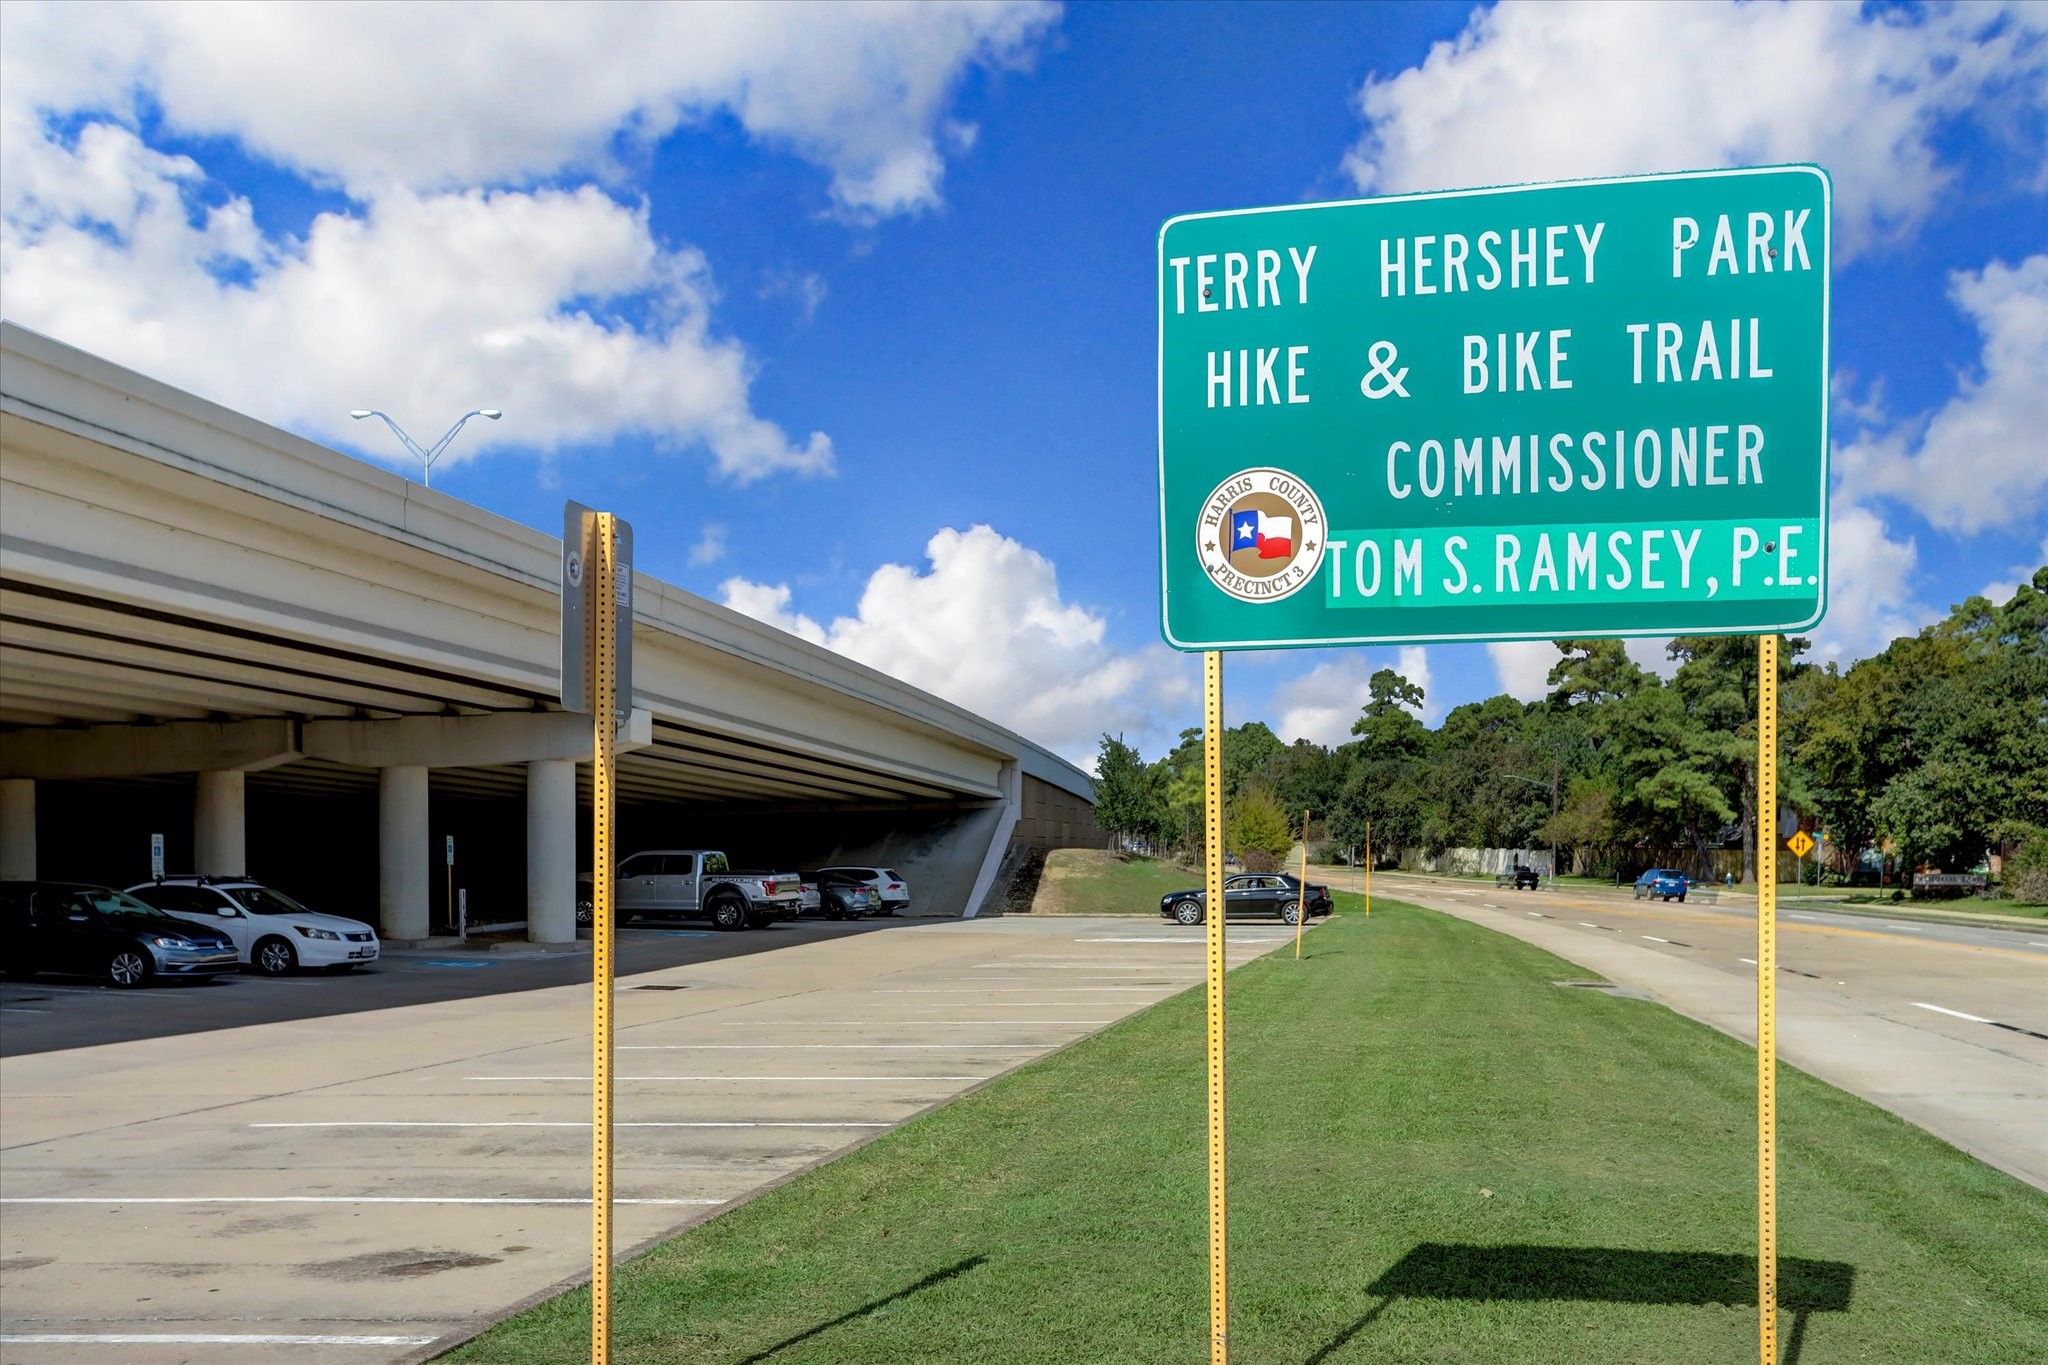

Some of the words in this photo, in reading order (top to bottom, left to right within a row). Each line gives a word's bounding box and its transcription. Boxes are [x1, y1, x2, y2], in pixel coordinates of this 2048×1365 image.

[1169, 245, 1318, 314] TERRY
[1380, 222, 1605, 298] HERSHEY
[1672, 209, 1812, 278] PARK
[1206, 345, 1311, 408] HIKE
[1360, 340, 1412, 400] &
[1463, 329, 1573, 394] BIKE
[1626, 318, 1774, 384] TRAIL
[1386, 424, 1765, 499] COMMISSIONER
[1204, 477, 1253, 528] HARRIS
[1269, 476, 1318, 526] COUNTY
[1213, 563, 1291, 595] PRECINCT
[1292, 565, 1305, 578] 3
[1326, 538, 1423, 598] TOM
[1732, 525, 1818, 587] P.E.
